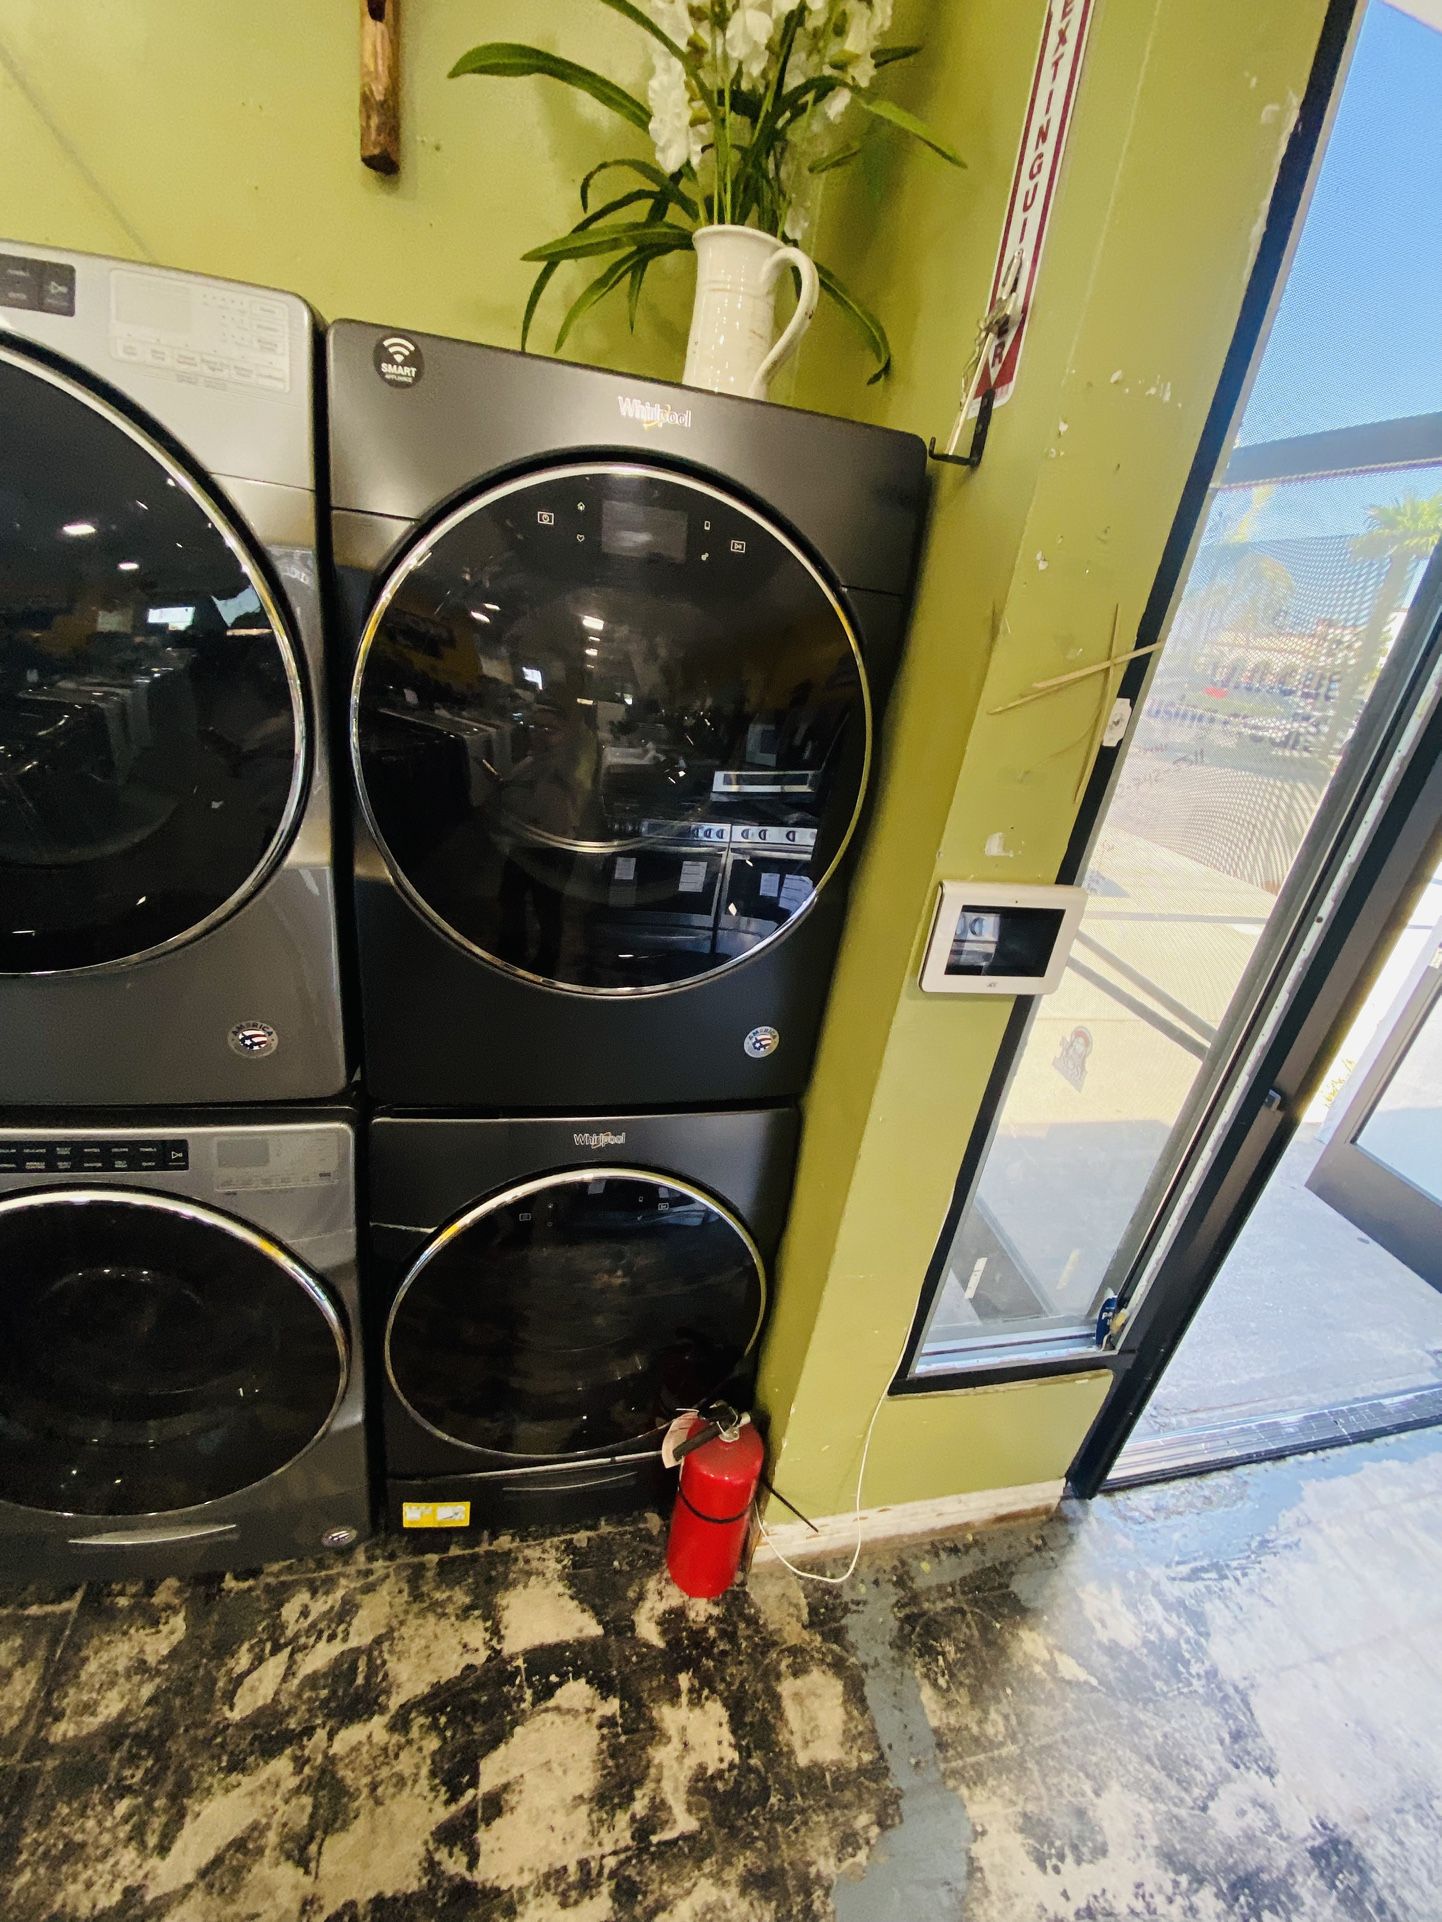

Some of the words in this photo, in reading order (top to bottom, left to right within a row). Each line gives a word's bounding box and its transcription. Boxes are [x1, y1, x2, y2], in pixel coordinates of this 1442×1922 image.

[991, 0, 1075, 368] EXTINGUIR
[381, 362, 417, 377] SMART
[617, 395, 692, 430] Whirlpool
[573, 1131, 626, 1149] Whirlpool
